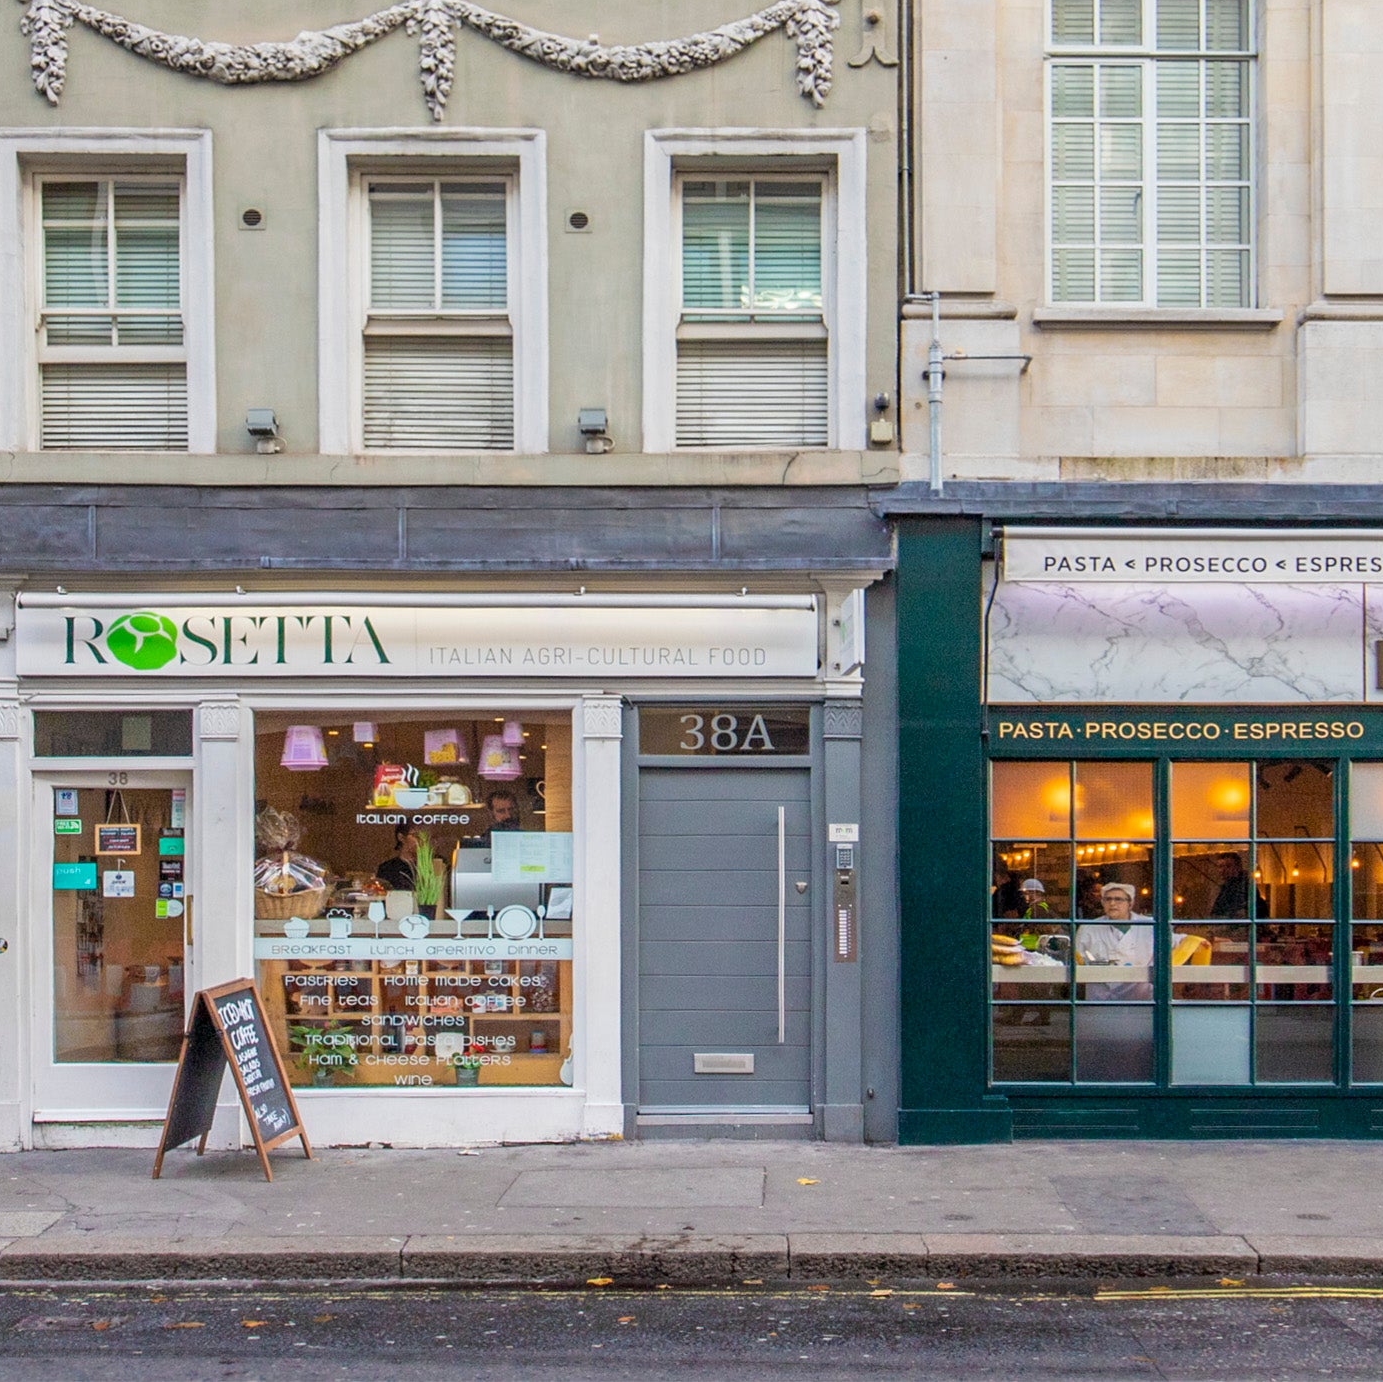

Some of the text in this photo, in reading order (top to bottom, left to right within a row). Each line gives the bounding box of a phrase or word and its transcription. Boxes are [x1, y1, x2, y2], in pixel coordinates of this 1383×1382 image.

[1043, 556, 1117, 573] PASTA
[1145, 557, 1268, 573] PROSECCO
[429, 647, 768, 667] ITALIAN AGRI-CULTURAL FOOD
[680, 714, 775, 750] 38A
[998, 722, 1365, 740] PASTA PROSECCO ESPRESSO
[108, 771, 128, 785] 38
[230, 1023, 259, 1050] COFFEE
[348, 1054, 359, 1066] &
